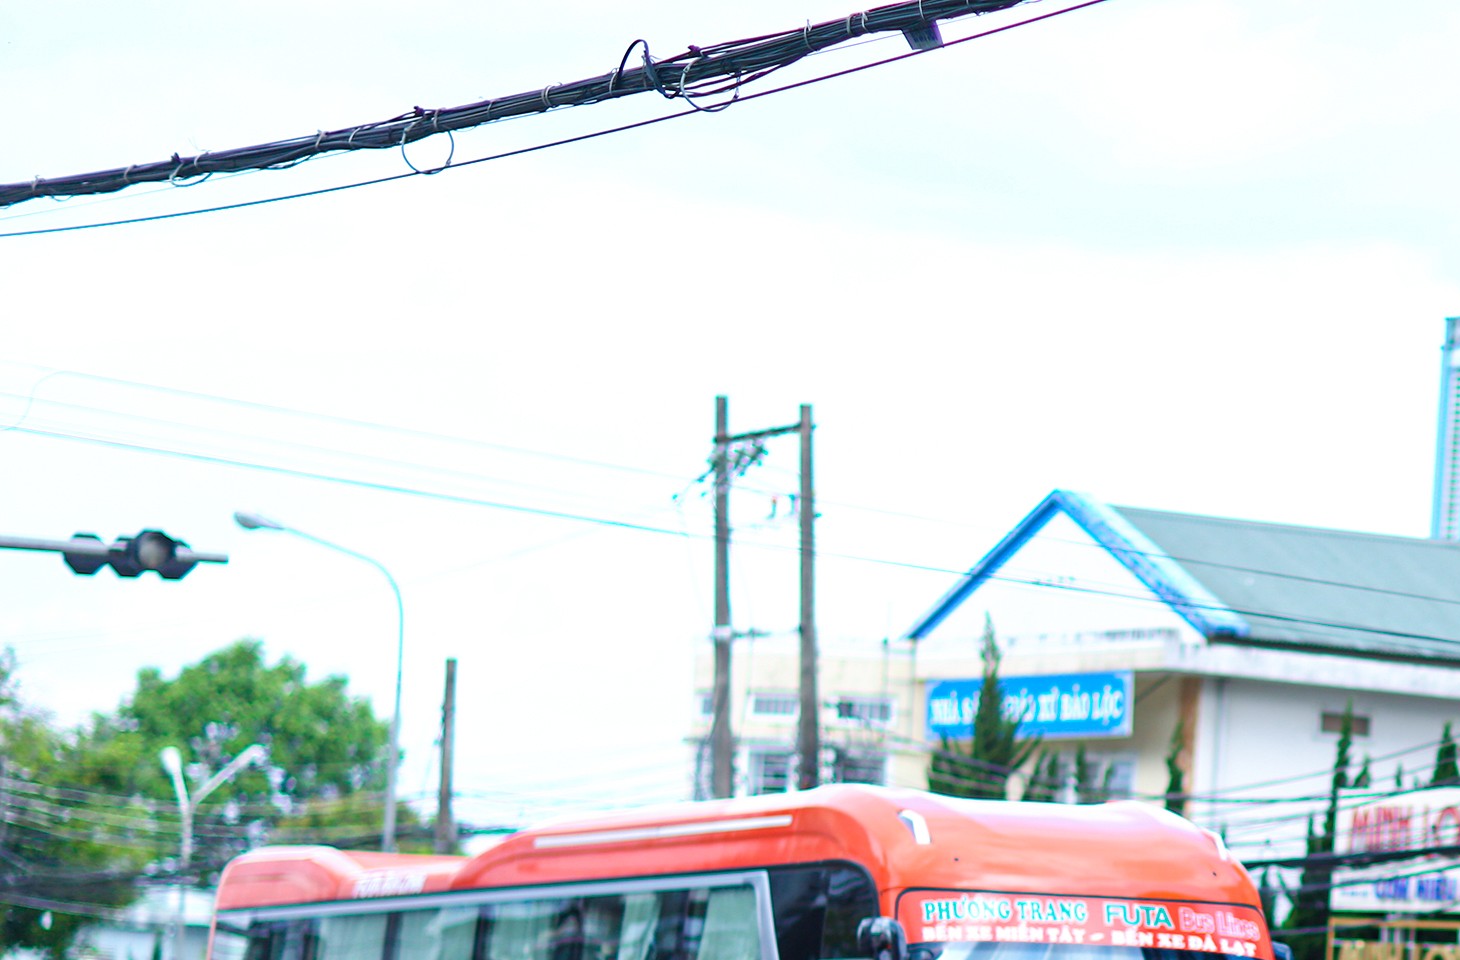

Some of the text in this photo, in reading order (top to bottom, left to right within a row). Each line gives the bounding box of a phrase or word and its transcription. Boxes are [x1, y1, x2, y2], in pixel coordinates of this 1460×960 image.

[923, 896, 1261, 941] PHƯƠNG TRANG FUTA Bus Lines
